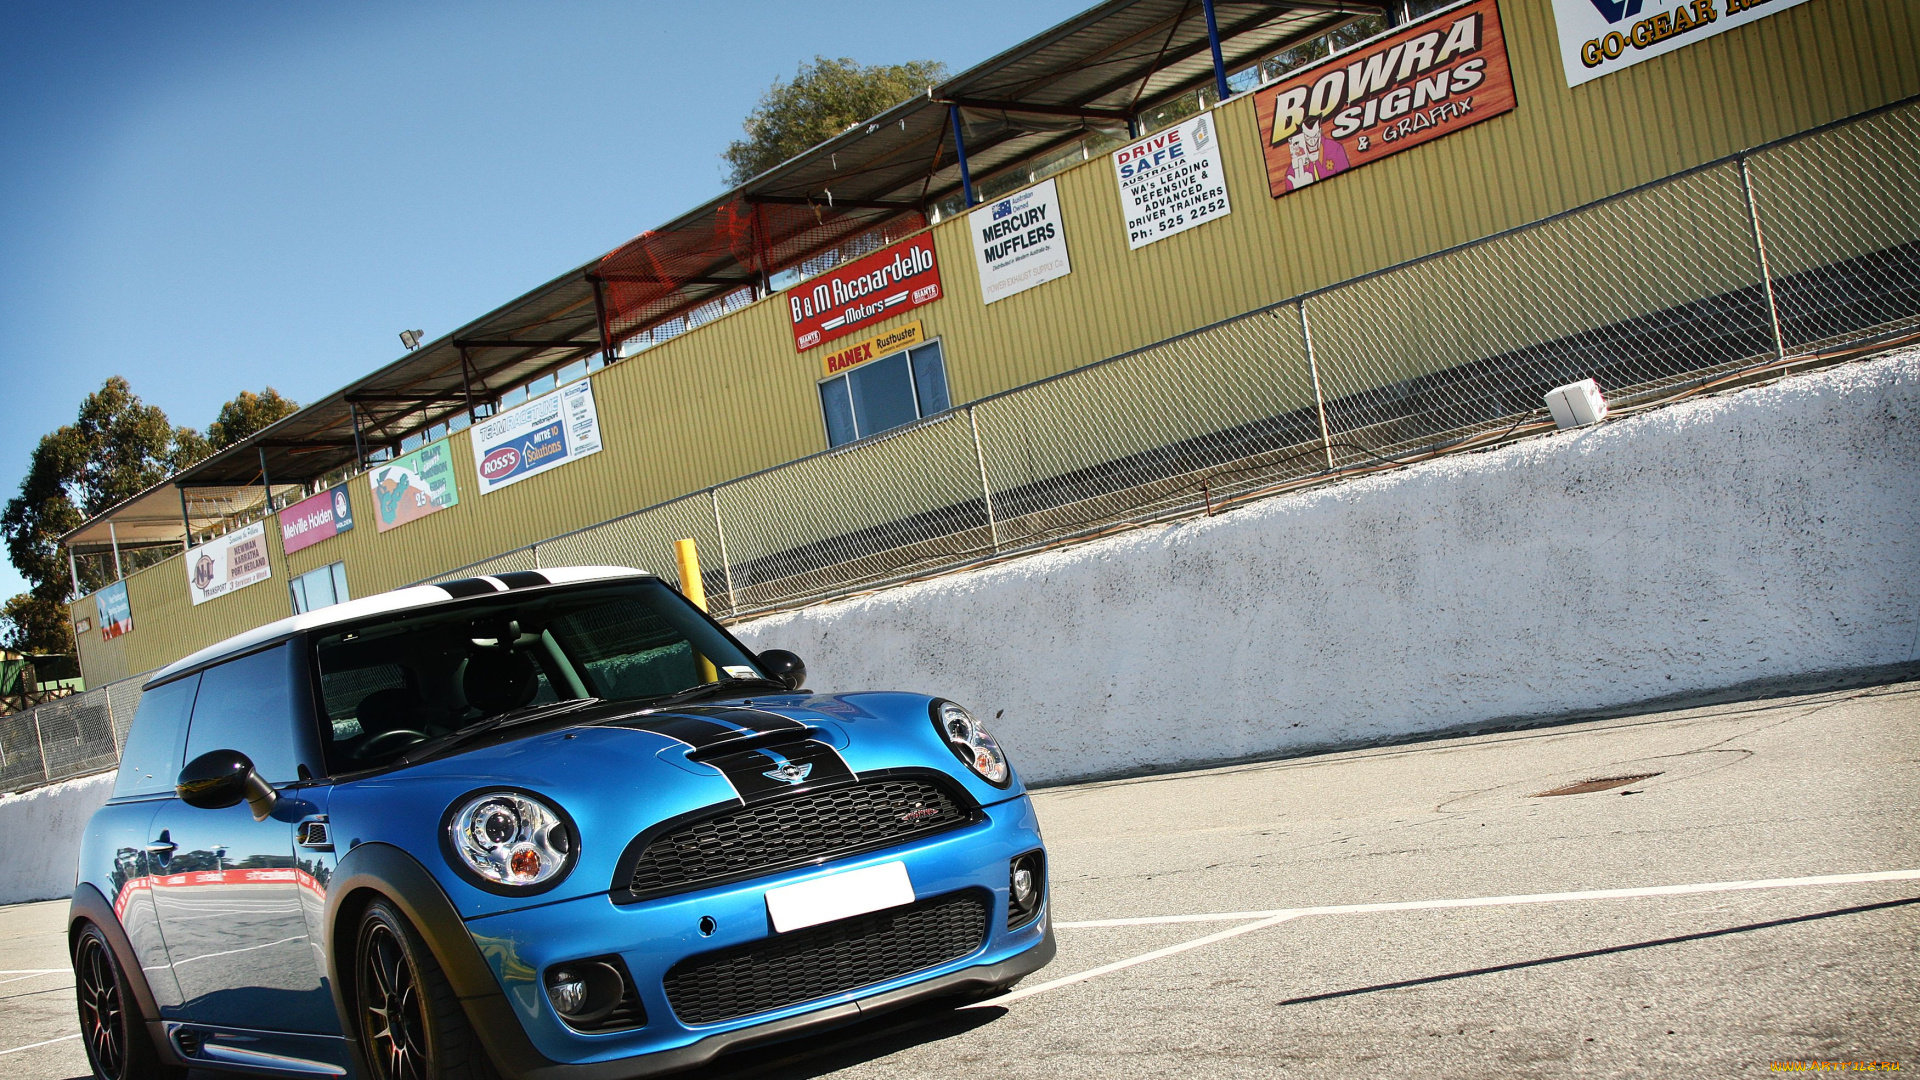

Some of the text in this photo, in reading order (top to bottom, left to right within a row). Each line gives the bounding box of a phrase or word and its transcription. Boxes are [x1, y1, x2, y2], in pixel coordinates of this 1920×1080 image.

[1271, 13, 1482, 146] BOWRA
[1330, 57, 1486, 139] SIGNS
[1357, 96, 1473, 151] & GRAFFIX
[1118, 130, 1180, 164] DRIVE
[1120, 143, 1184, 178] SAFE
[1122, 158, 1186, 188] AUSTRALIA
[1131, 159, 1209, 196] WA's LEADING
[1135, 170, 1209, 206] DEFENSIVE &
[1012, 191, 1033, 204] Australian
[1012, 201, 1029, 213] Owned
[1129, 186, 1223, 229] DRIVER TRAINERS
[1145, 183, 1203, 213] ADVANCED
[982, 203, 1047, 244] MERCURY
[1131, 198, 1226, 242] Ph: 525 2252
[984, 222, 1055, 264] MUFFLERS
[790, 245, 933, 323] B & M Ricciardello
[986, 280, 1007, 294] POWER
[1008, 270, 1032, 287] EXHAUST
[845, 300, 884, 324] Motors
[827, 327, 916, 373] RANEX Rustbuster
[480, 416, 507, 442] TEAM
[507, 396, 559, 431] RACETUNE
[531, 411, 559, 428] motorsport
[534, 428, 551, 444] MITRE
[551, 425, 559, 436] 10
[484, 452, 516, 475] ROSS'S
[526, 440, 562, 463] Solutions
[415, 491, 427, 507] 25
[283, 509, 333, 540] Melville Holden
[336, 518, 352, 529] HOLDEN
[234, 539, 256, 555] NEWMAN
[234, 548, 259, 566] KARRATHA
[231, 556, 266, 577] PORT HEDLAND
[205, 582, 227, 598] TRANSPORT
[229, 581, 235, 590] 3
